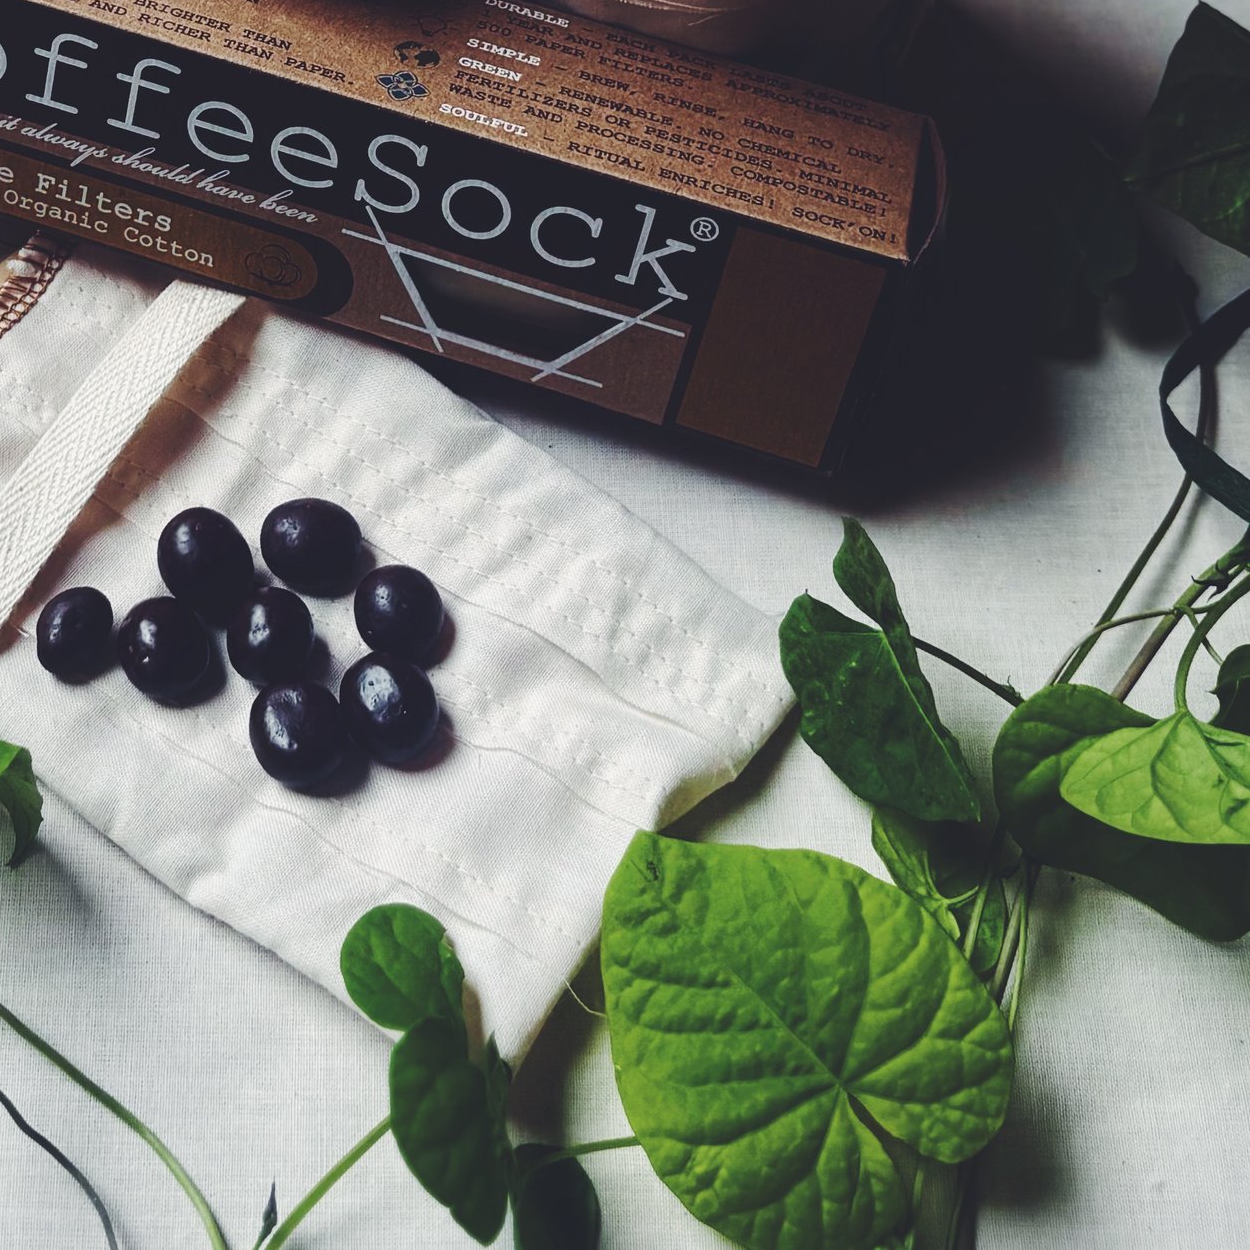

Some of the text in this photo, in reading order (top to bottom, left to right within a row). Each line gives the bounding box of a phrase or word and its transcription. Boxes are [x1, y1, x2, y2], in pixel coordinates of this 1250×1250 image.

[137, 13, 211, 42] RICHER
[224, 38, 274, 61] THAN
[283, 56, 355, 85] PAPER.
[242, 29, 293, 51] THAN
[477, 21, 694, 90] 500 PAPER FILTERS.
[506, 16, 554, 36] YEAR
[564, 33, 603, 50] AND
[614, 48, 714, 81] REPLACES
[726, 79, 893, 132] APPROXIMATELY
[606, 32, 656, 53] EACH
[668, 50, 716, 70] PACK
[729, 67, 791, 90] LASTS
[803, 88, 867, 111] ABOUT
[449, 83, 887, 218] WASTE AND PROCESSING. COMPOSTABLE!
[453, 70, 892, 204] FERTILIZERS OR PESTICIDES. MINIMAL
[458, 56, 523, 82] GREEN
[558, 86, 682, 129] RENEWABLE.
[699, 126, 725, 141] NO
[738, 138, 842, 174] CHEMICAL
[466, 38, 542, 67] SIMPLE
[578, 70, 640, 96] BREW,
[654, 92, 725, 121] RINSE,
[742, 118, 795, 140] HANG
[808, 136, 834, 150] TO
[847, 148, 895, 168] DRY.
[20, 123, 108, 167] always
[111, 147, 205, 185] should
[196, 170, 256, 204] have
[259, 189, 319, 224] been
[34, 172, 172, 232] Filters
[439, 103, 528, 137] SOULFUL
[568, 140, 646, 172] RITUAL
[657, 167, 775, 210] ENRICHES!
[3, 189, 108, 233] Organic
[123, 227, 214, 267] Cotton
